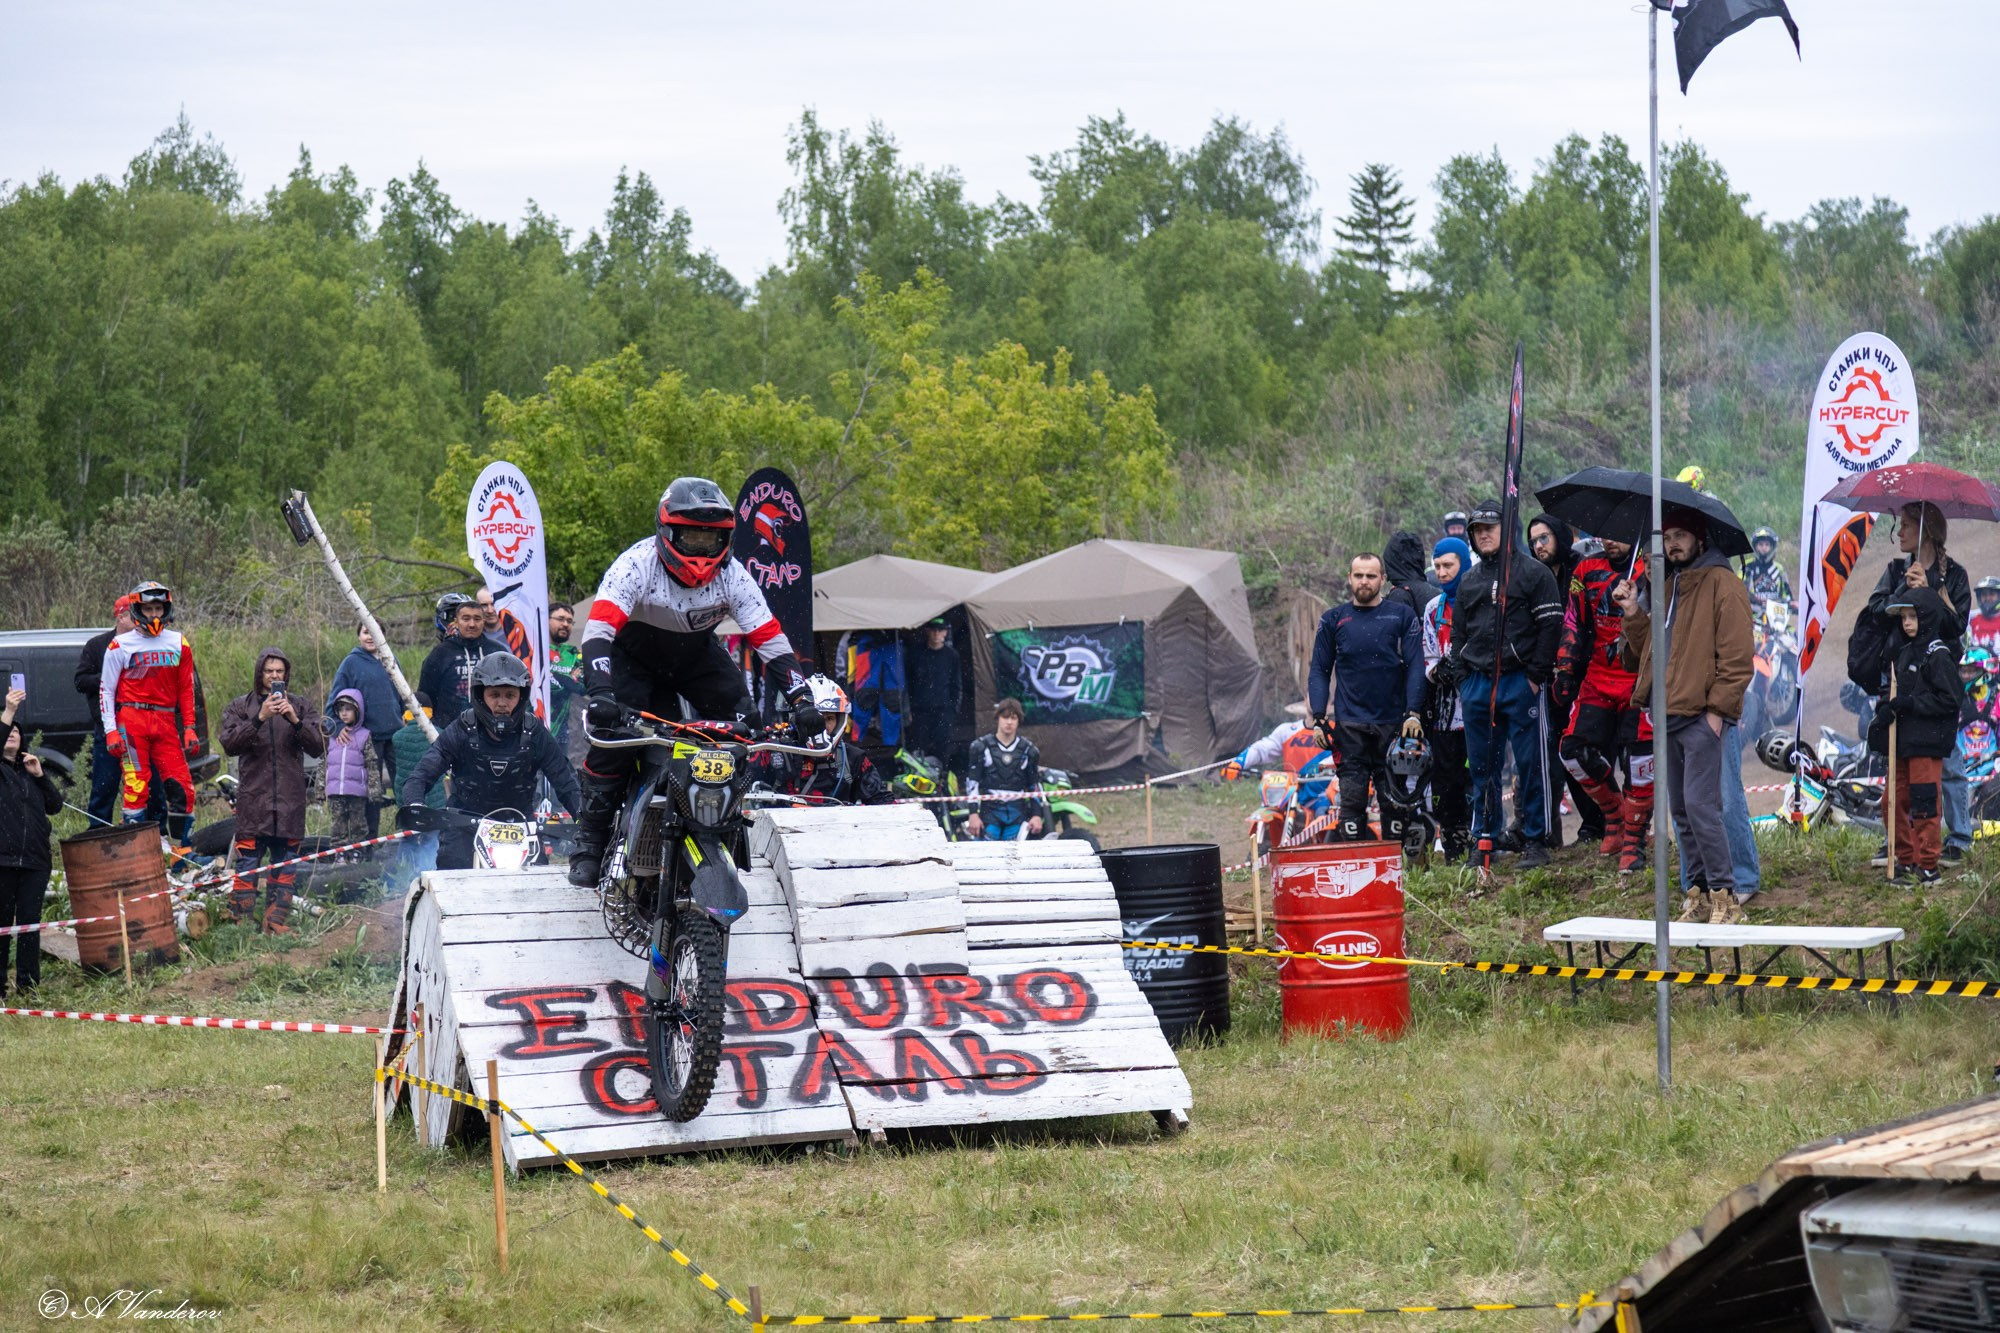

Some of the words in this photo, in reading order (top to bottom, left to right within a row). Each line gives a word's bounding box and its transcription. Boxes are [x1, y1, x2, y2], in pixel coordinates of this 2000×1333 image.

[1828, 347, 1870, 392] СТАНКИ
[1874, 348, 1898, 374] ЧПУ
[1819, 406, 1910, 424] HYPERCUT
[1825, 440, 1841, 461] ДЛЯ
[1839, 456, 1866, 473] РЕЗКИ
[1866, 438, 1903, 472] МЕТАЛЛА
[477, 474, 506, 513] СТАНКИ
[508, 475, 525, 496] ЧПУ
[739, 482, 803, 522] ENDURO
[473, 523, 536, 538] HYPERCUT
[134, 651, 175, 667] LEATT
[703, 760, 723, 776] 38
[494, 829, 519, 841] 710
[1135, 957, 1185, 970] RADIO
